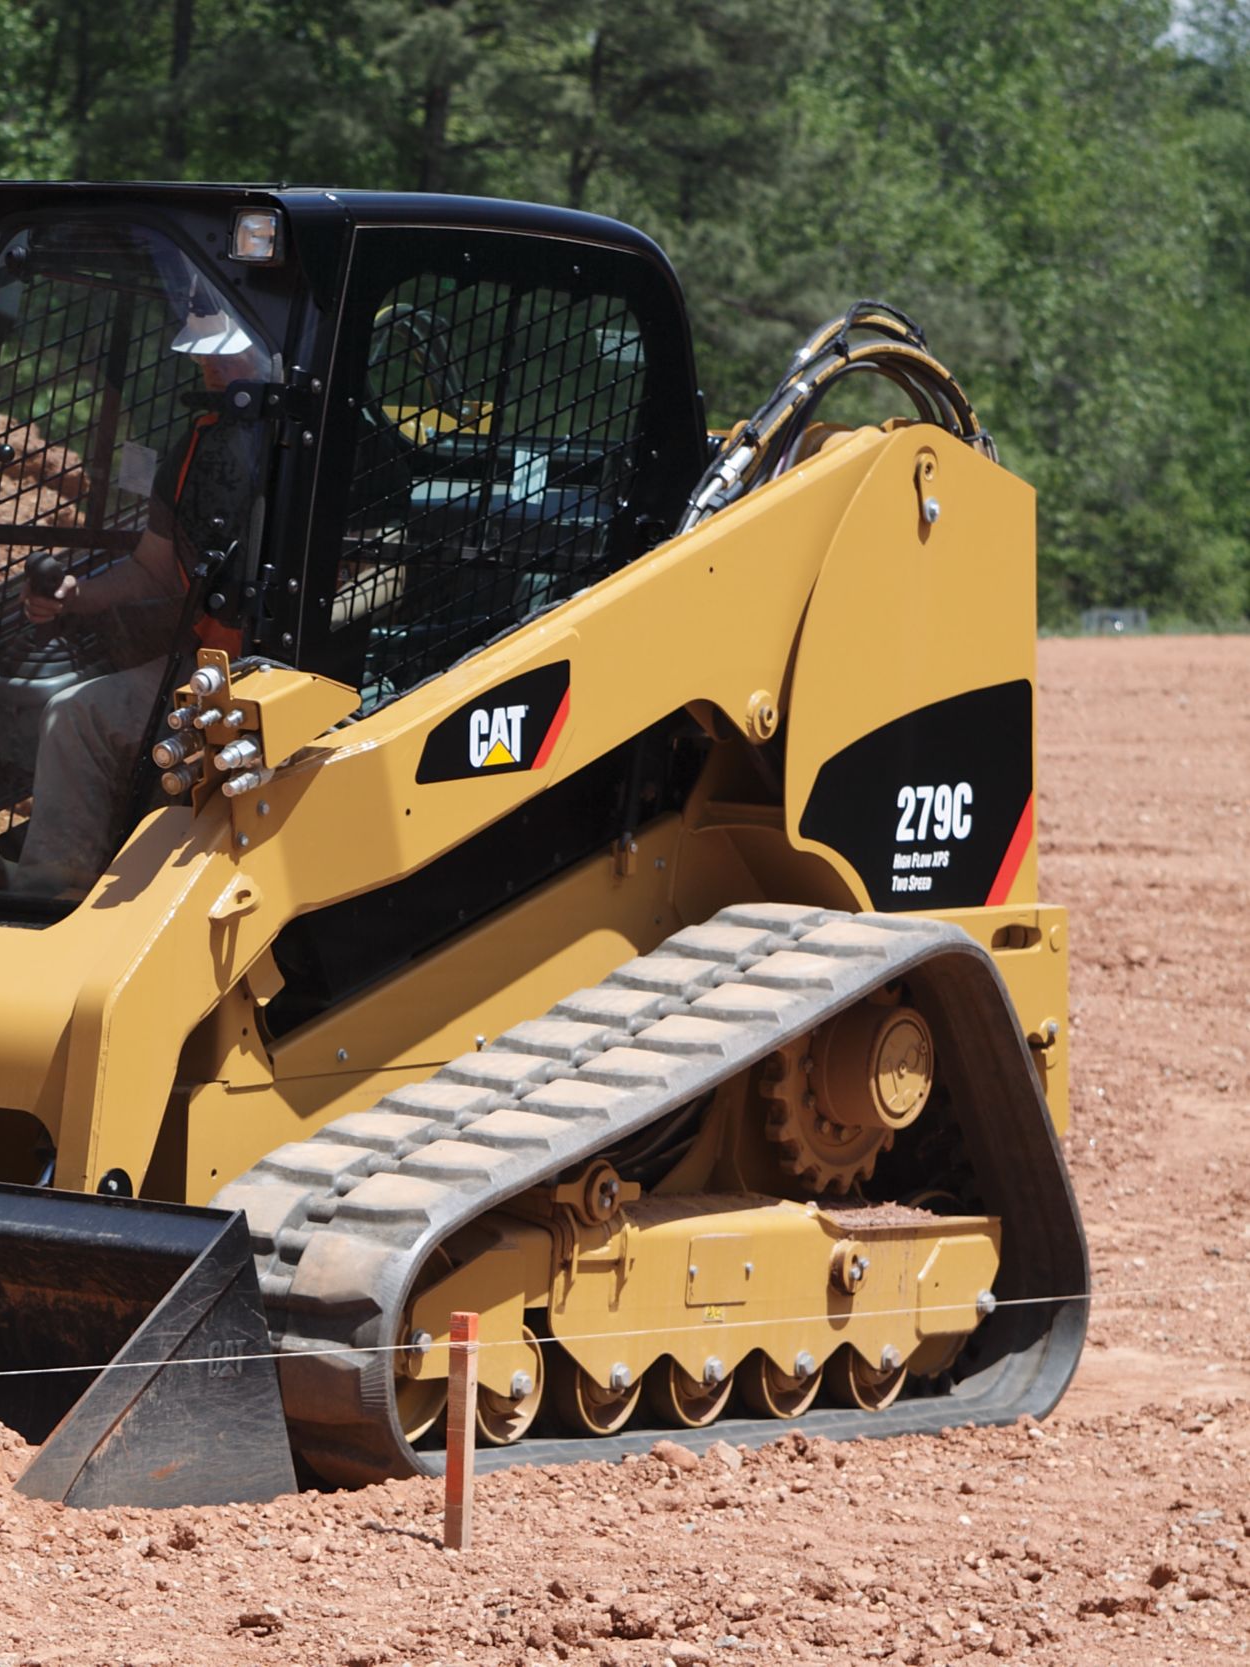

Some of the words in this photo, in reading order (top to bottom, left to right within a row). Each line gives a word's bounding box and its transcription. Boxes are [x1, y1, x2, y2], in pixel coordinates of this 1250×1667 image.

[469, 705, 526, 768] CAT
[895, 782, 973, 841] 279C
[931, 850, 950, 867] XPS
[208, 1339, 247, 1378] CAT
